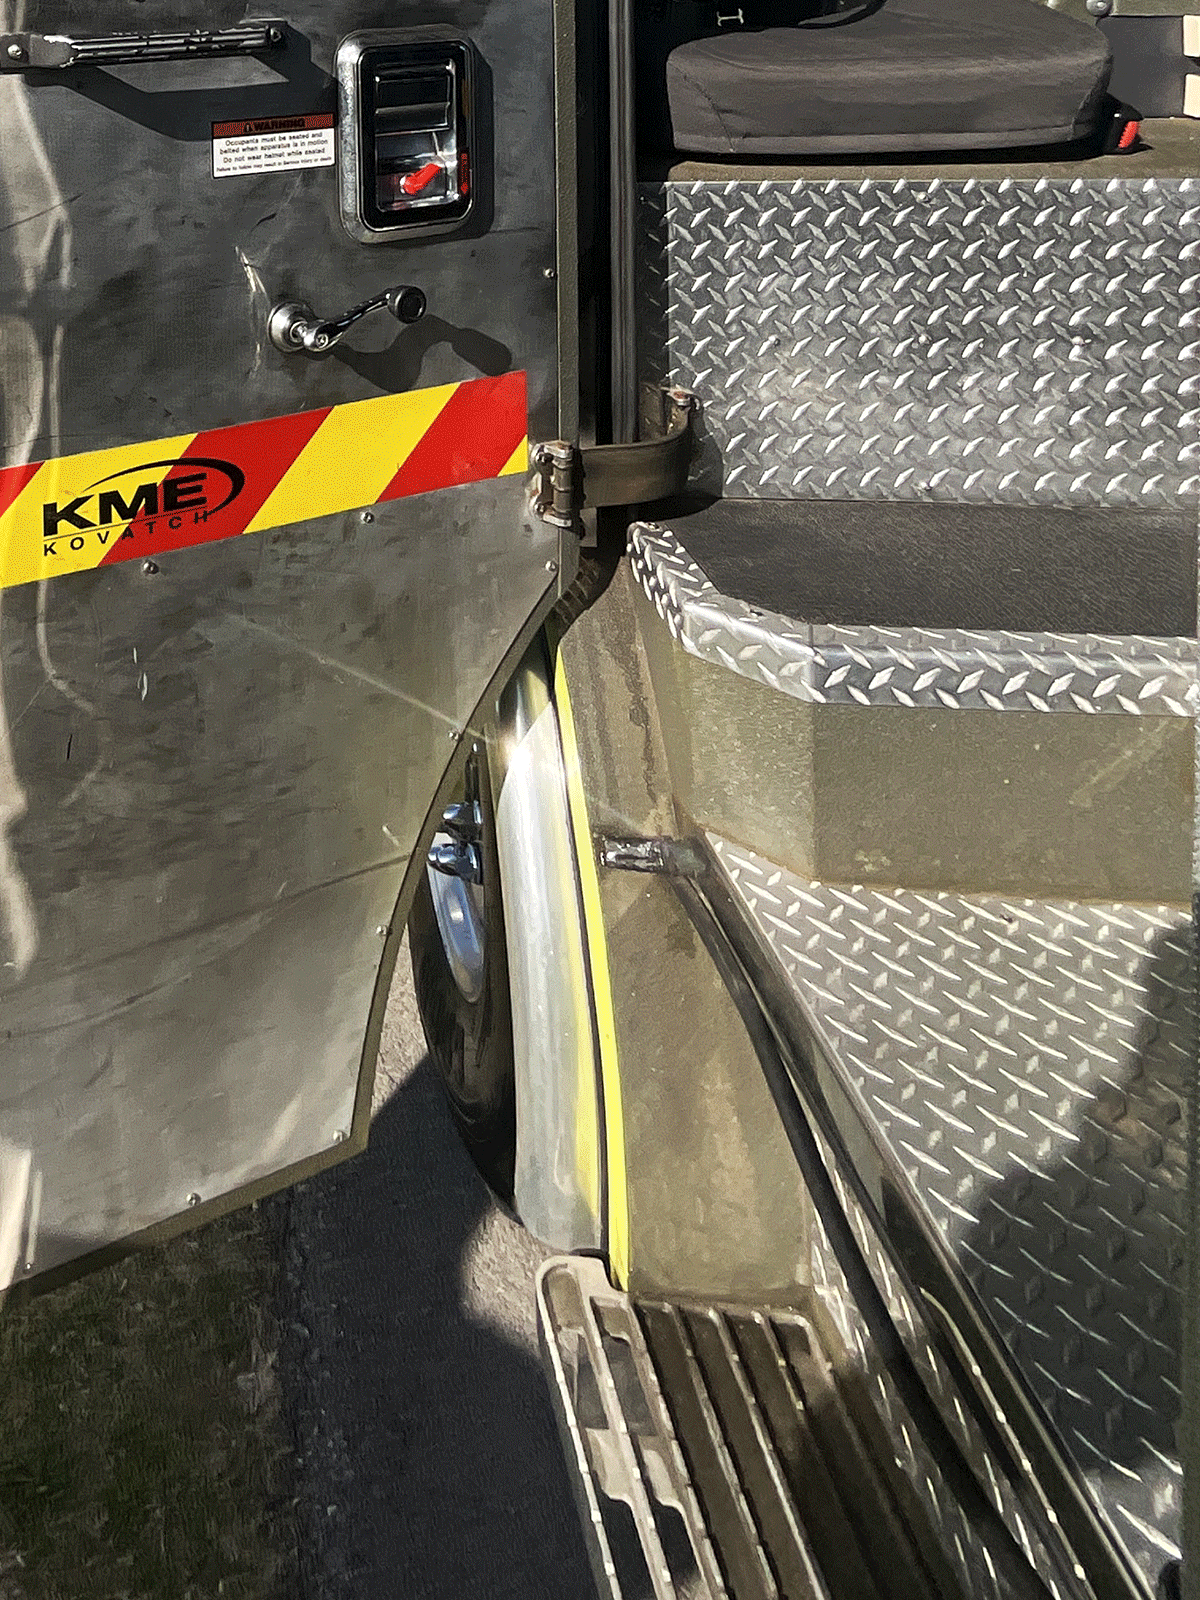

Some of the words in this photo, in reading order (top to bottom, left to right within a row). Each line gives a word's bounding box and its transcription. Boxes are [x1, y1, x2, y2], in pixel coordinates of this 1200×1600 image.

[254, 118, 305, 132] WARNING
[225, 138, 258, 146] Occupants
[260, 142, 290, 151] apparatus
[264, 151, 285, 159] helmet
[305, 147, 325, 155] seated
[43, 472, 208, 537] KME
[43, 511, 209, 557] KOVATCH
